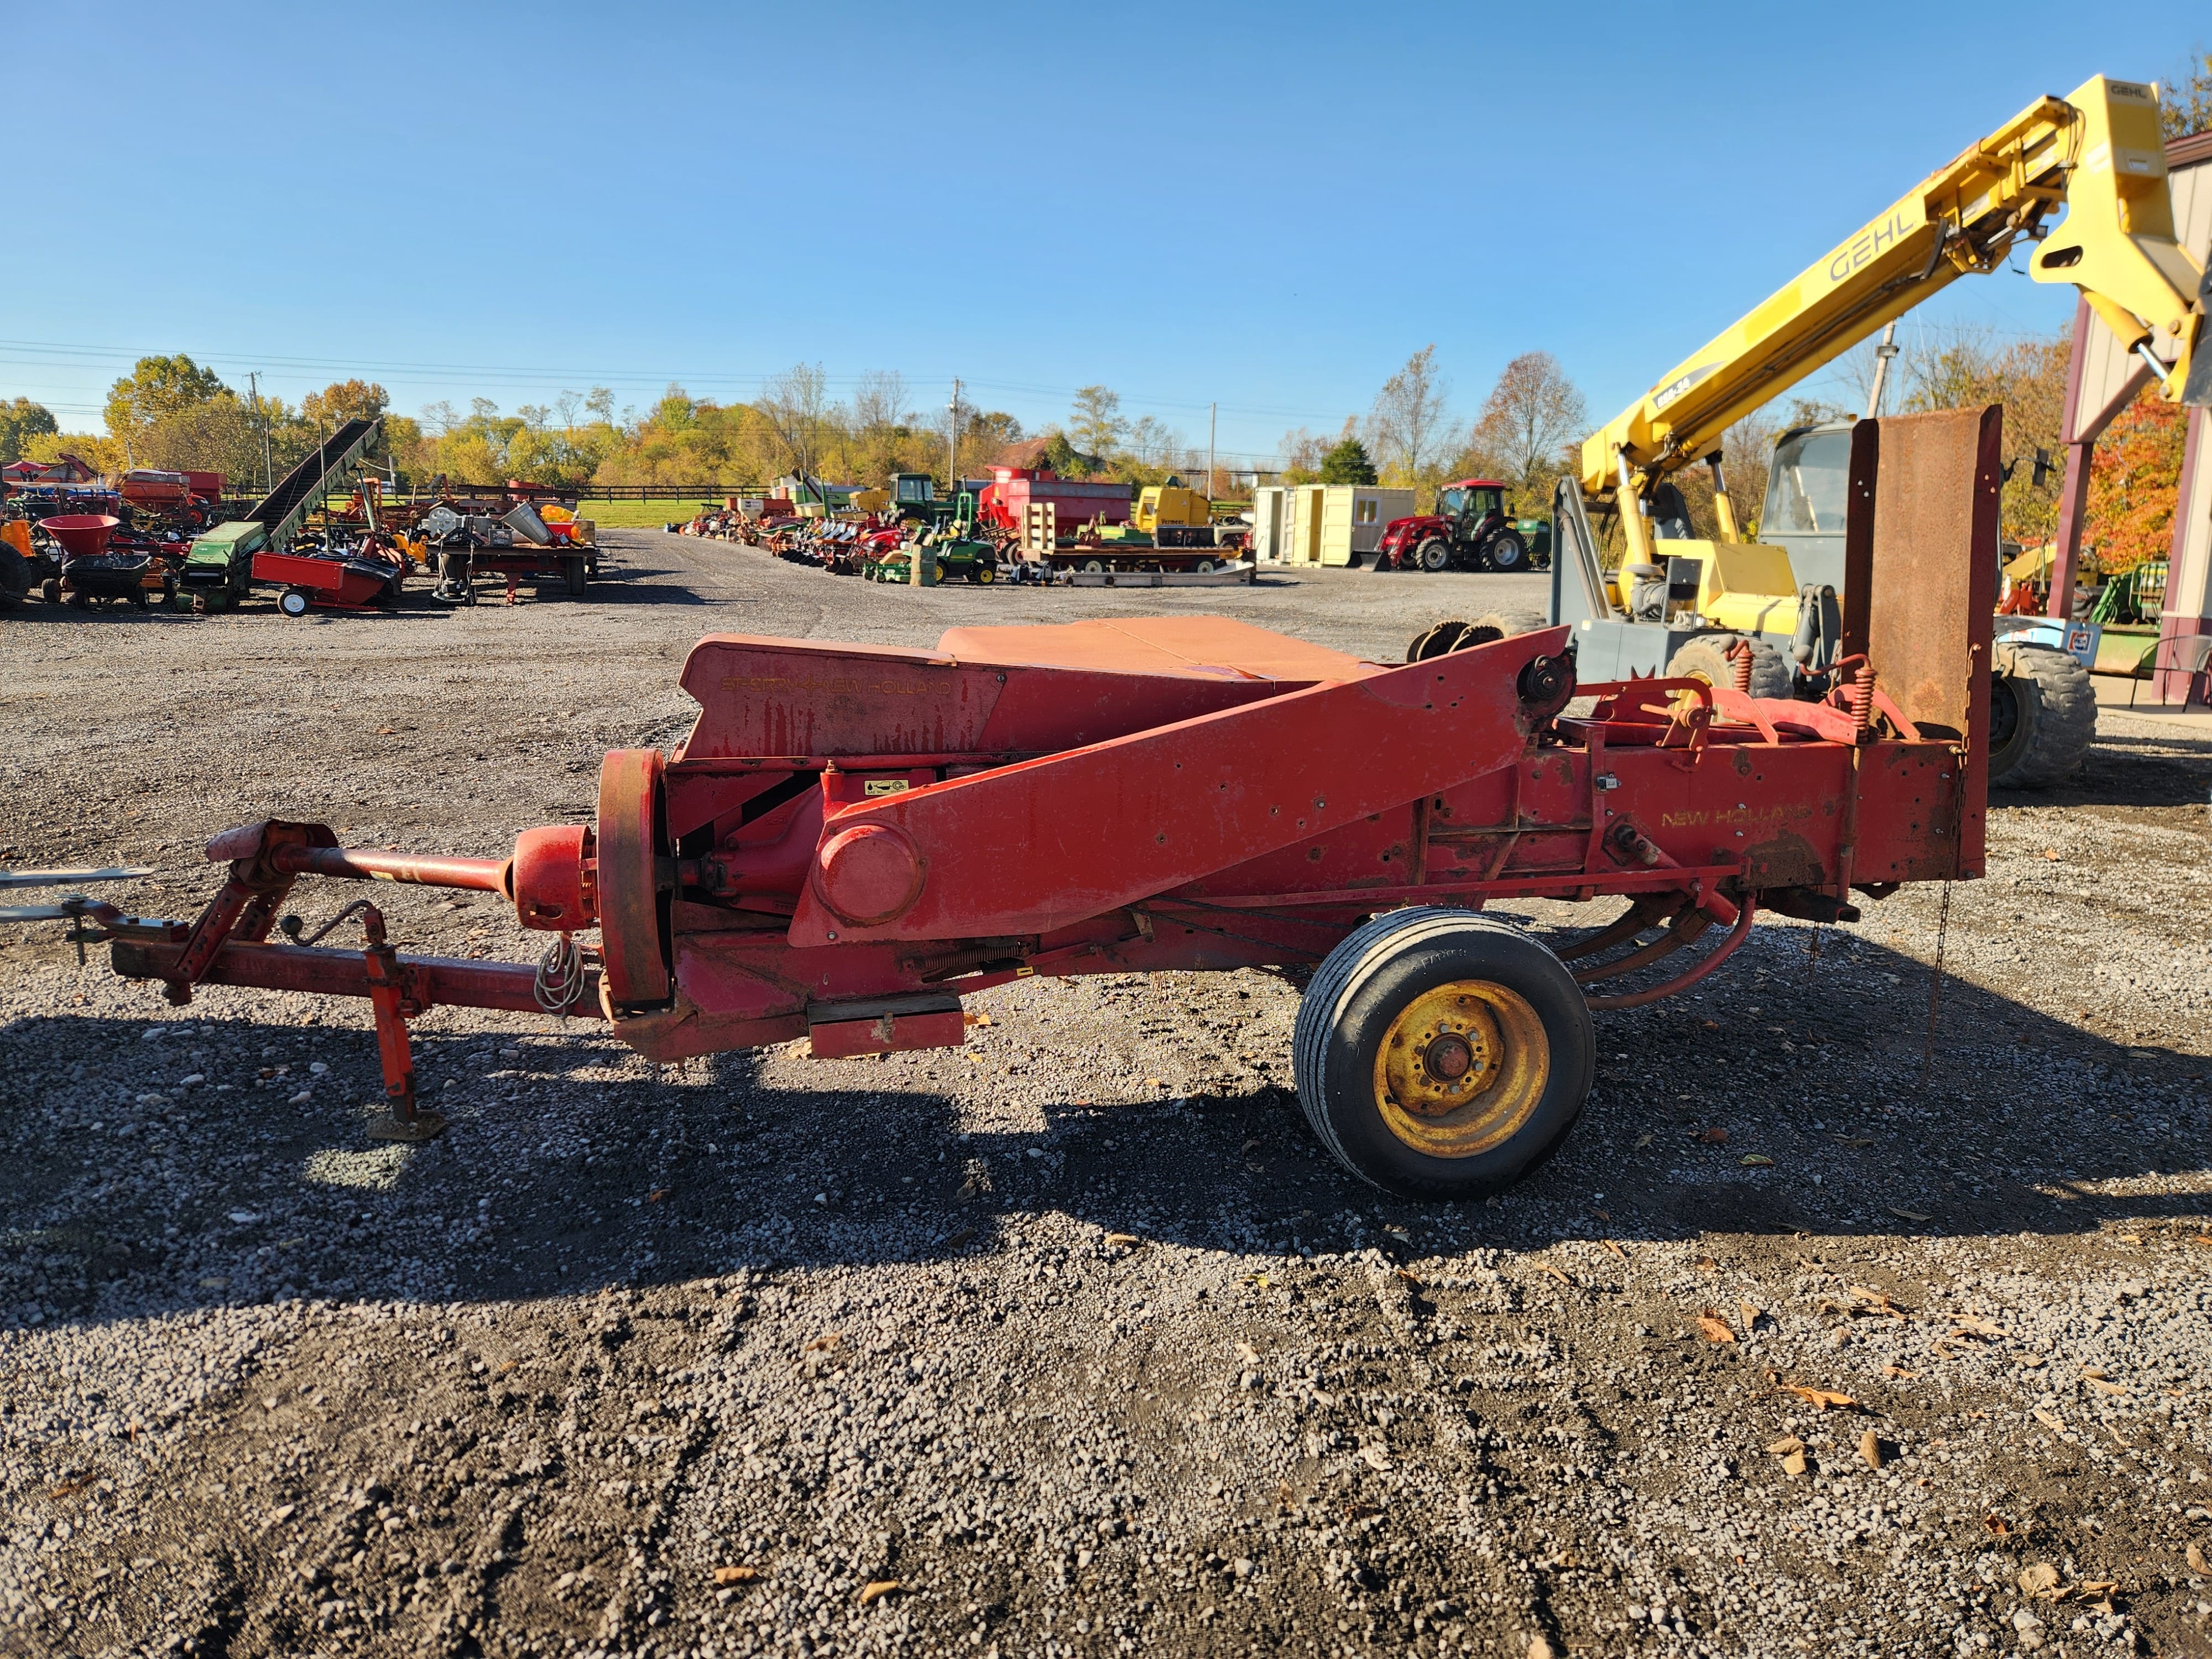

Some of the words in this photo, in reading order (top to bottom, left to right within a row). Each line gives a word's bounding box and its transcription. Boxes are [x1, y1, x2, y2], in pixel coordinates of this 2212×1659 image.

[2111, 85, 2148, 98] GEHL
[1830, 212, 1914, 281] GEHL
[721, 676, 799, 692] SPERRY
[823, 678, 863, 693] NEW
[868, 680, 951, 695] HOLLAND
[1662, 811, 1709, 827] NEW
[1716, 805, 1812, 823] HOLLAND
